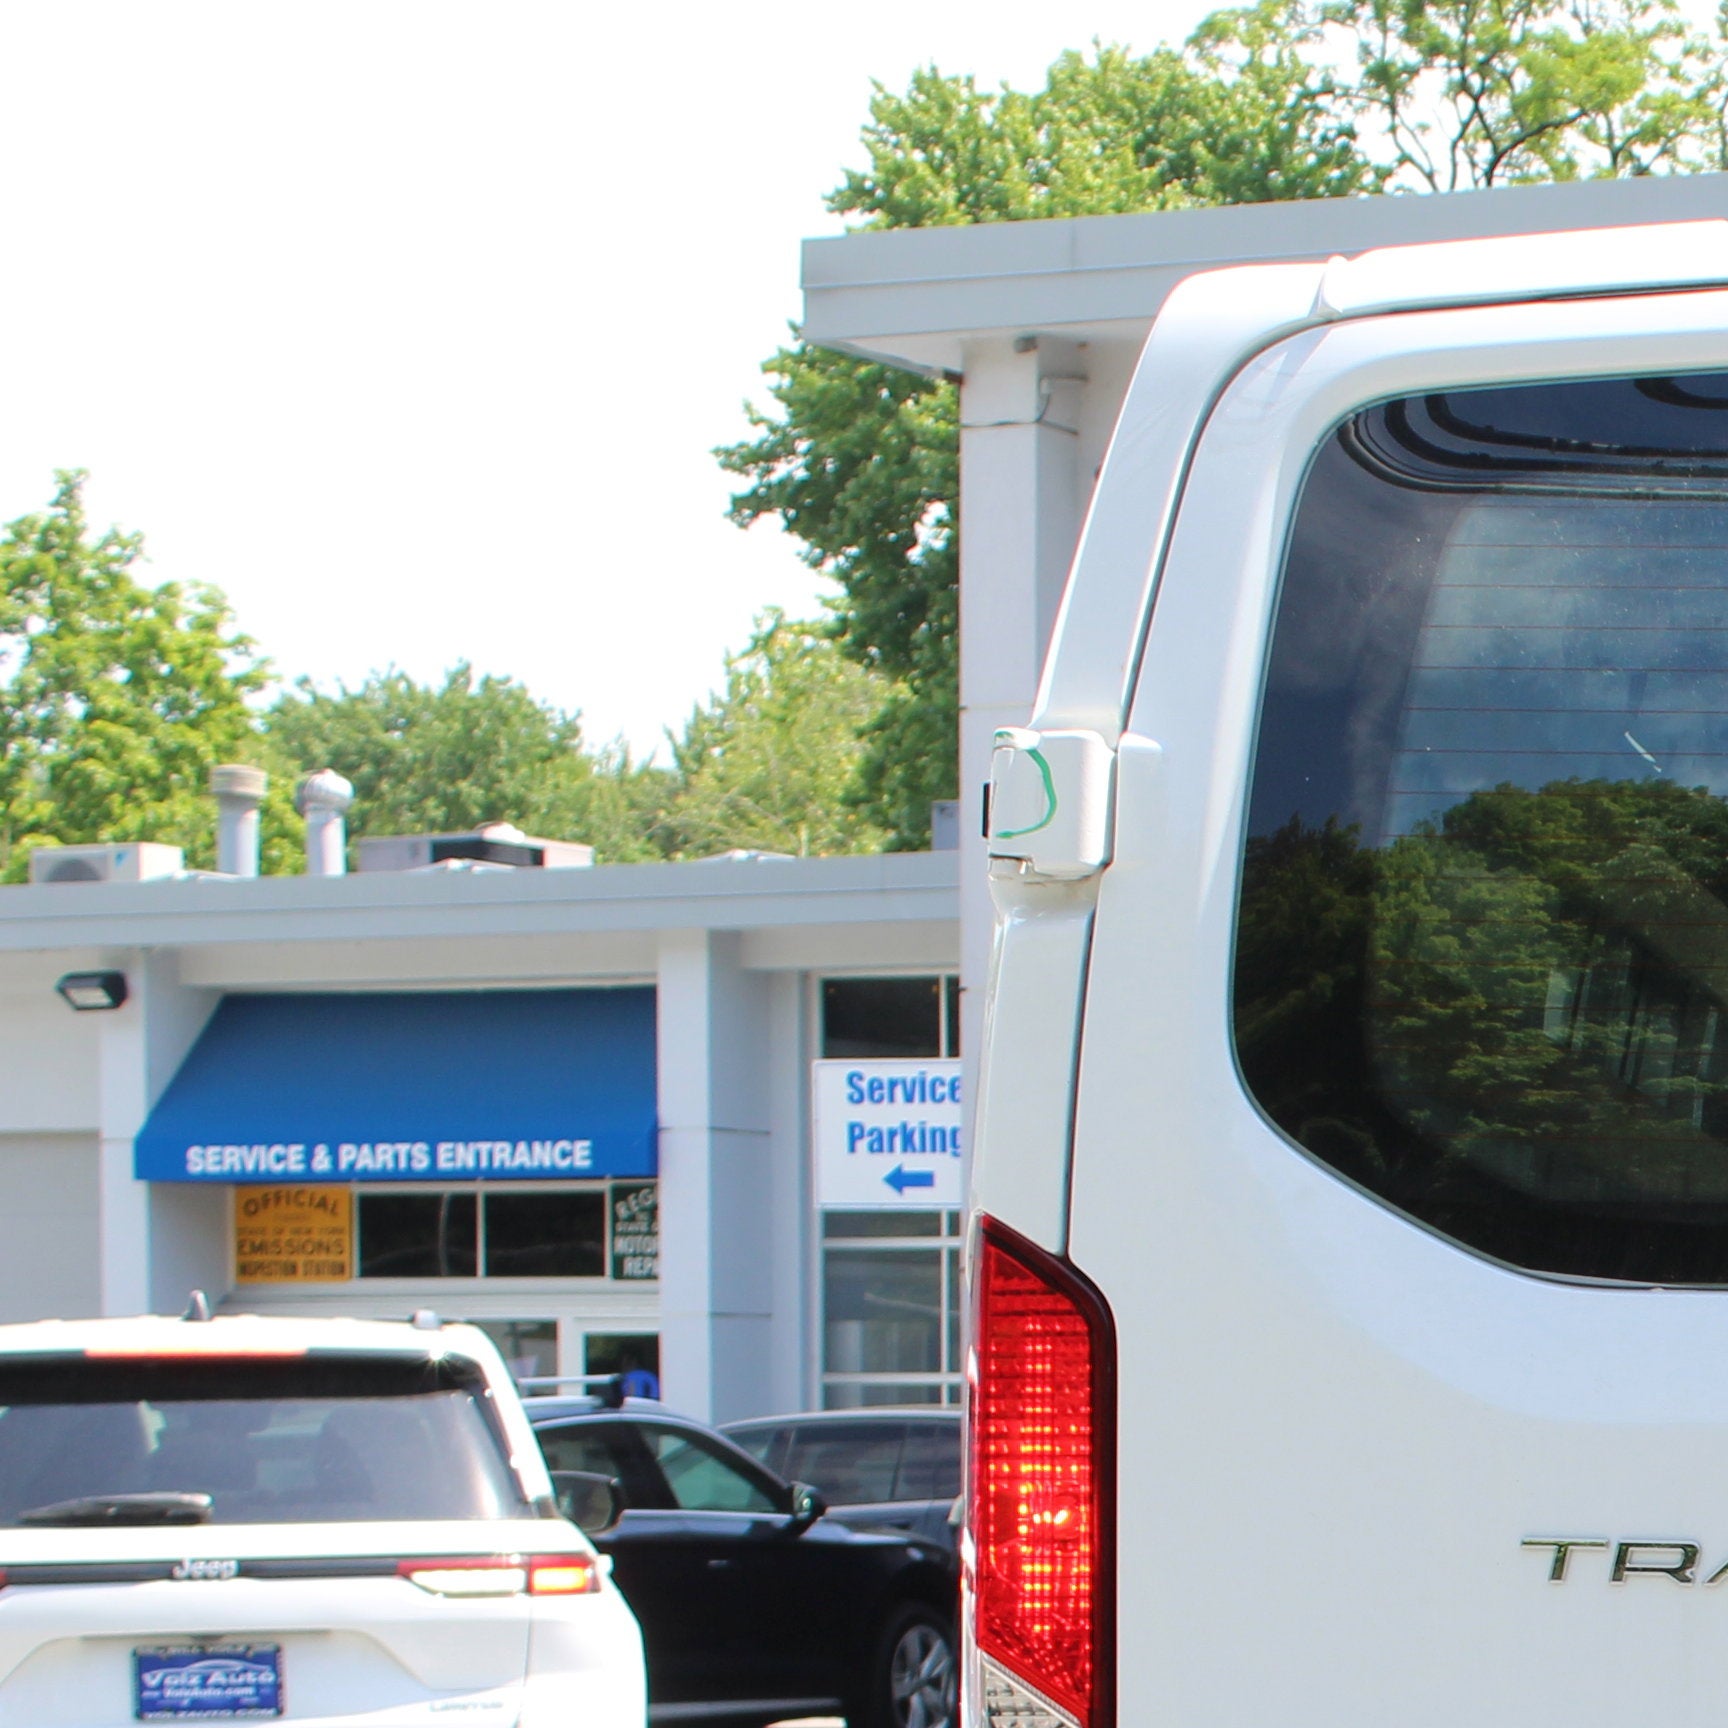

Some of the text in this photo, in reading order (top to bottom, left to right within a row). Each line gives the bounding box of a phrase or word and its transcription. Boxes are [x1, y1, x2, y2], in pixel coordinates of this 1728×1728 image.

[846, 1070, 961, 1104] Service
[846, 1120, 961, 1158] Parking
[186, 1139, 593, 1174] SERVICE & PARTS ENTRANCE
[243, 1188, 339, 1218] OFFICIAL
[238, 1238, 345, 1256] EMISSIONS
[172, 1557, 238, 1579] Jeep
[141, 1670, 277, 1688] Volz Auto
